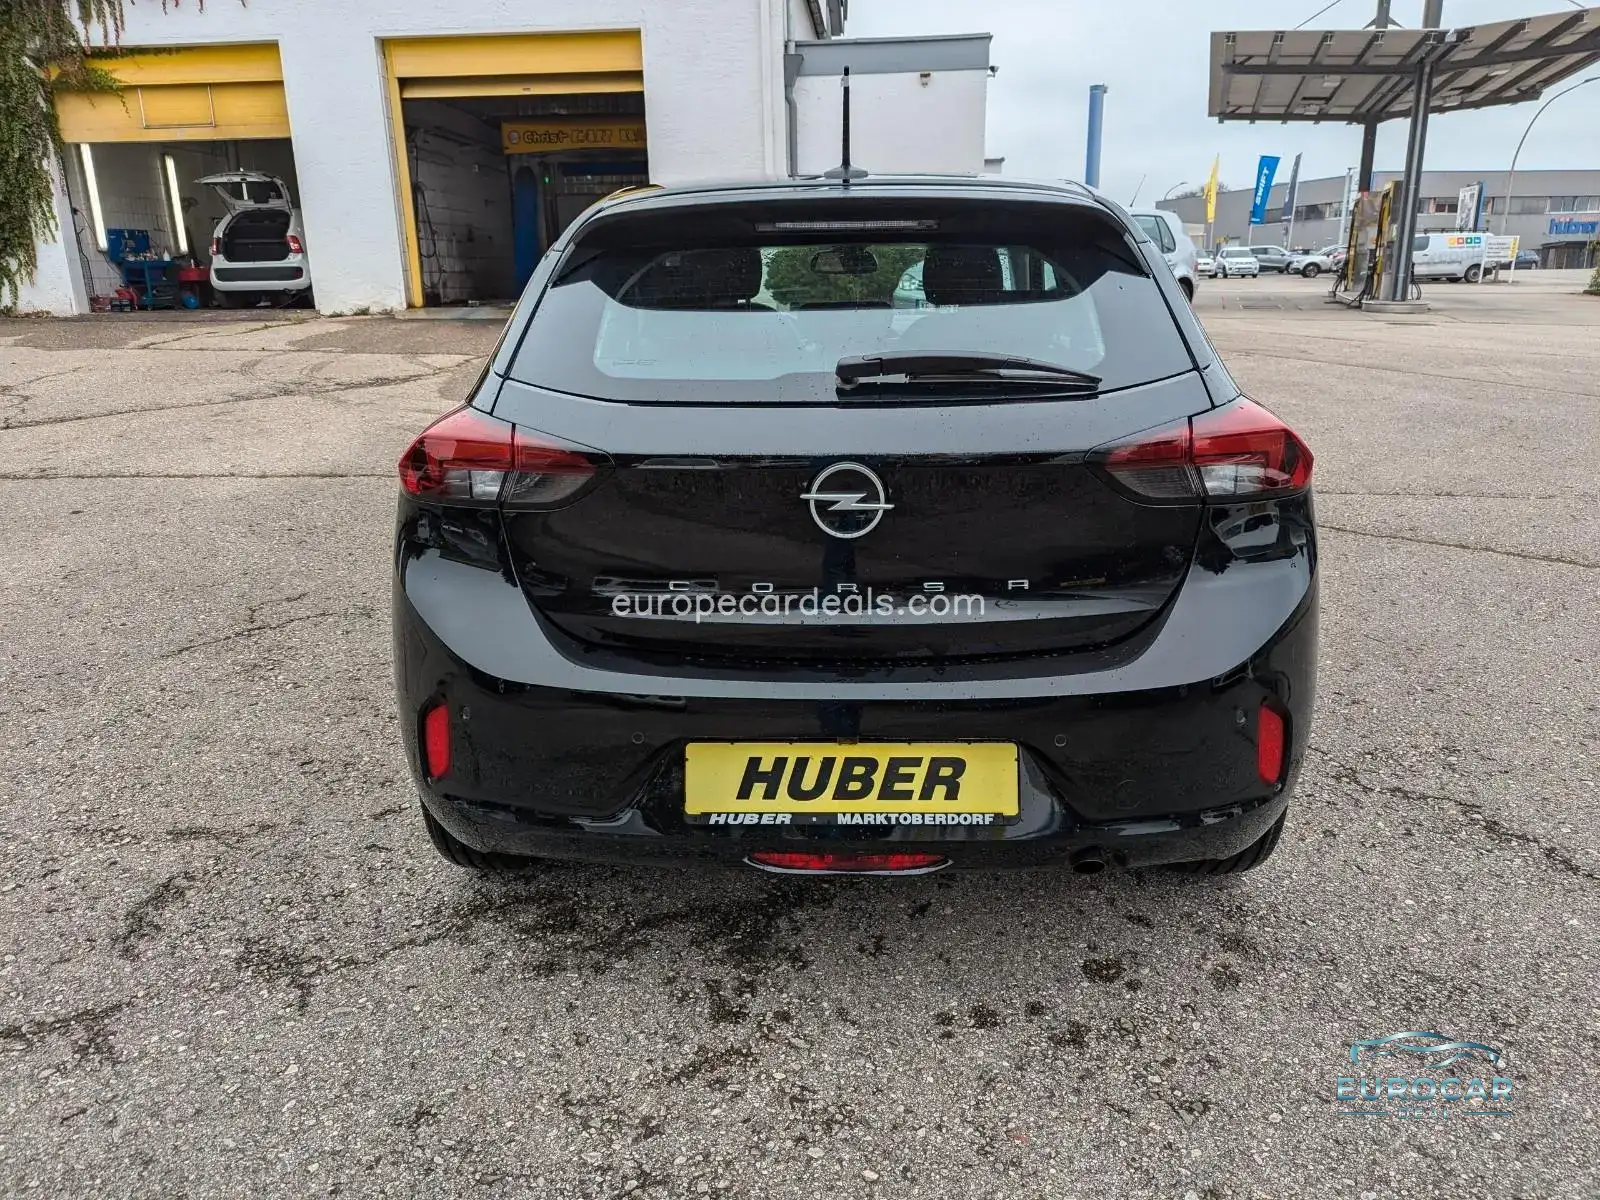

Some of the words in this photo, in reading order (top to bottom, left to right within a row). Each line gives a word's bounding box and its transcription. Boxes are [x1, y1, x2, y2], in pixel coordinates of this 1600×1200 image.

[523, 130, 568, 144] Christ
[1255, 166, 1269, 205] SWIFT
[668, 579, 1029, 593] CORSA
[736, 757, 967, 801] HUBER
[709, 813, 792, 825] HUBER
[837, 813, 995, 825] MARKTOBERDORF
